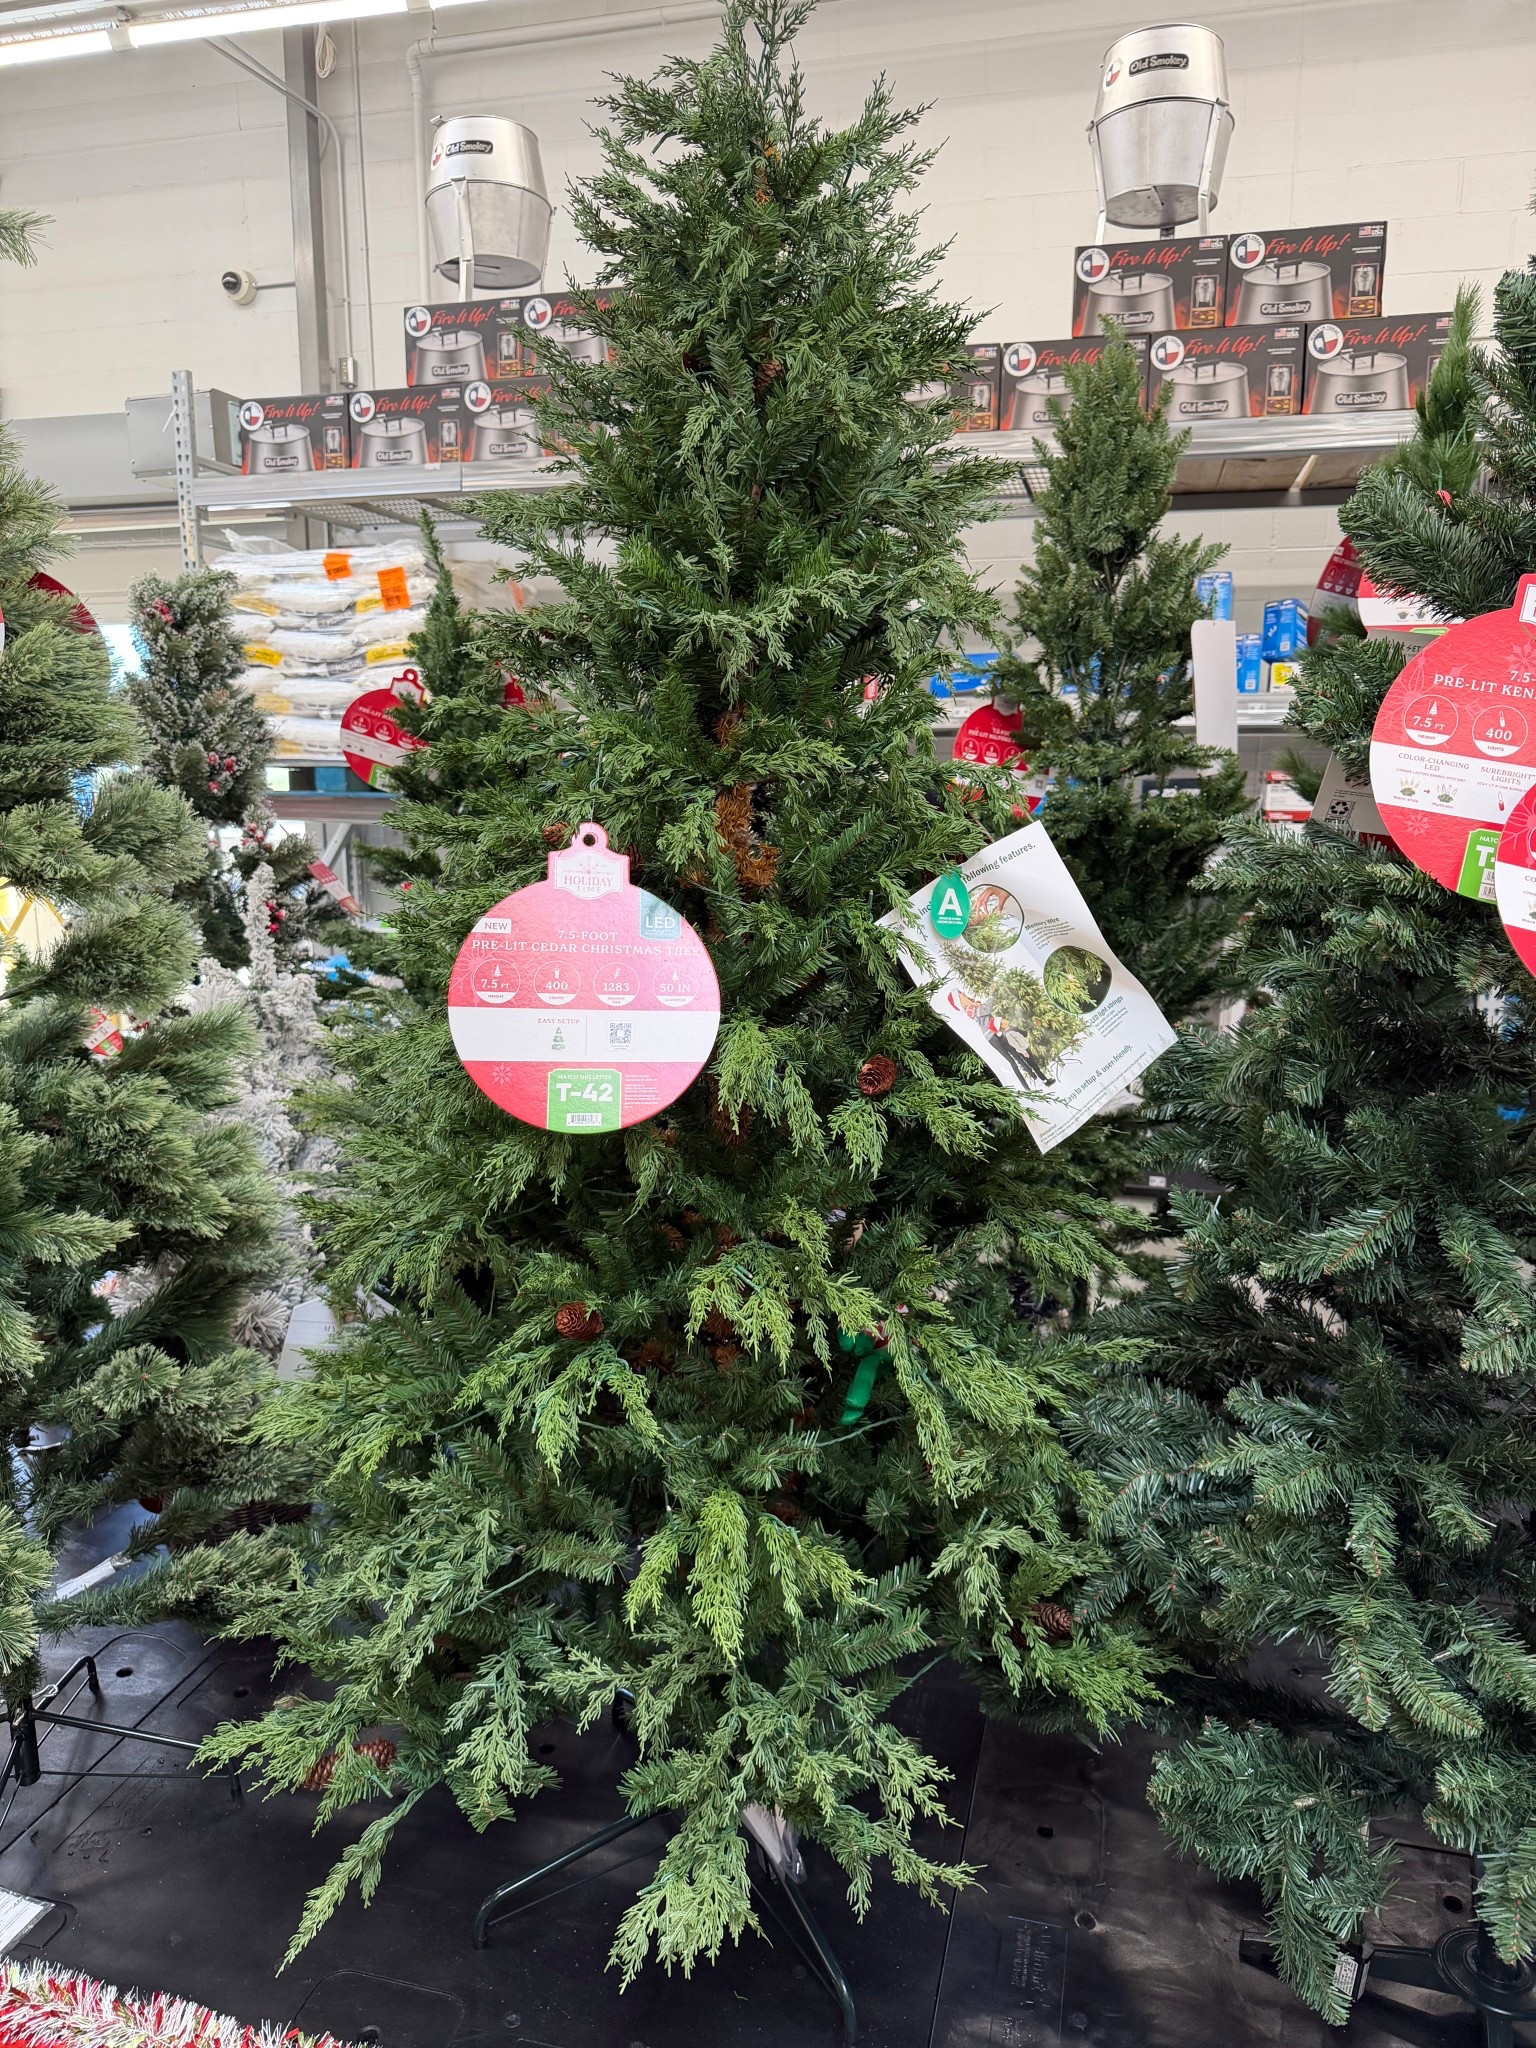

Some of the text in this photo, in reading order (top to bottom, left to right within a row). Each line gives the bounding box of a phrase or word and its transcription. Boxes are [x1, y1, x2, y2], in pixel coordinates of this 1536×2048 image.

[1130, 54, 1188, 74] Old Smokey
[446, 141, 492, 155] Old Smokey
[1266, 237, 1297, 256] Fire
[1298, 236, 1314, 253] It
[1314, 233, 1350, 257] Up!
[1109, 249, 1140, 267] Fire
[1141, 248, 1157, 265] It
[1156, 245, 1192, 270] Up!
[1261, 304, 1278, 314] Old
[431, 306, 495, 328] Fire It Up!
[1343, 328, 1373, 346] Fire
[1374, 327, 1390, 344] It
[1390, 324, 1428, 349] Up!
[1184, 339, 1215, 356] Fire
[1216, 337, 1230, 354] It
[1231, 335, 1266, 359] Up!
[1035, 349, 1065, 366] Fire
[491, 388, 513, 403] Fire
[1336, 393, 1353, 405] Old
[264, 402, 321, 422] Fire It Up!
[375, 394, 437, 415] Fire It Up!
[1433, 673, 1536, 700] PRE-LIT KEN
[1412, 715, 1446, 730] 7.5 FT
[1417, 733, 1436, 741] HEIGHT
[1485, 727, 1513, 742] 400
[1398, 752, 1470, 770] COLOR-CHANGING
[1424, 763, 1440, 772] LED
[1491, 775, 1521, 786] LIGHTS
[1479, 835, 1498, 844] MATC
[962, 860, 1001, 884] following
[999, 842, 1036, 865] features.
[563, 875, 615, 888] HOLIDAY
[576, 885, 602, 893] TIME
[938, 887, 963, 917] A
[484, 921, 508, 931] NEW
[645, 916, 676, 929] LED
[1024, 917, 1060, 931] Memory Wire
[558, 929, 619, 941] 7.5-FOOT
[471, 939, 527, 951] PRE-LIT
[531, 942, 577, 953] CEDAR
[581, 943, 661, 955] CHRISTMAS
[481, 978, 498, 989] 7.5
[545, 980, 569, 991] 400
[603, 982, 630, 992] 1283
[660, 983, 691, 993] 50 IN
[1097, 1006, 1109, 1018] light
[1107, 995, 1124, 1010] strings
[1063, 1091, 1078, 1106] Easy
[1080, 1074, 1097, 1091] setup
[1095, 1069, 1103, 1077] &
[1101, 1043, 1134, 1073] user-friendly.
[555, 1082, 614, 1102] T-42
